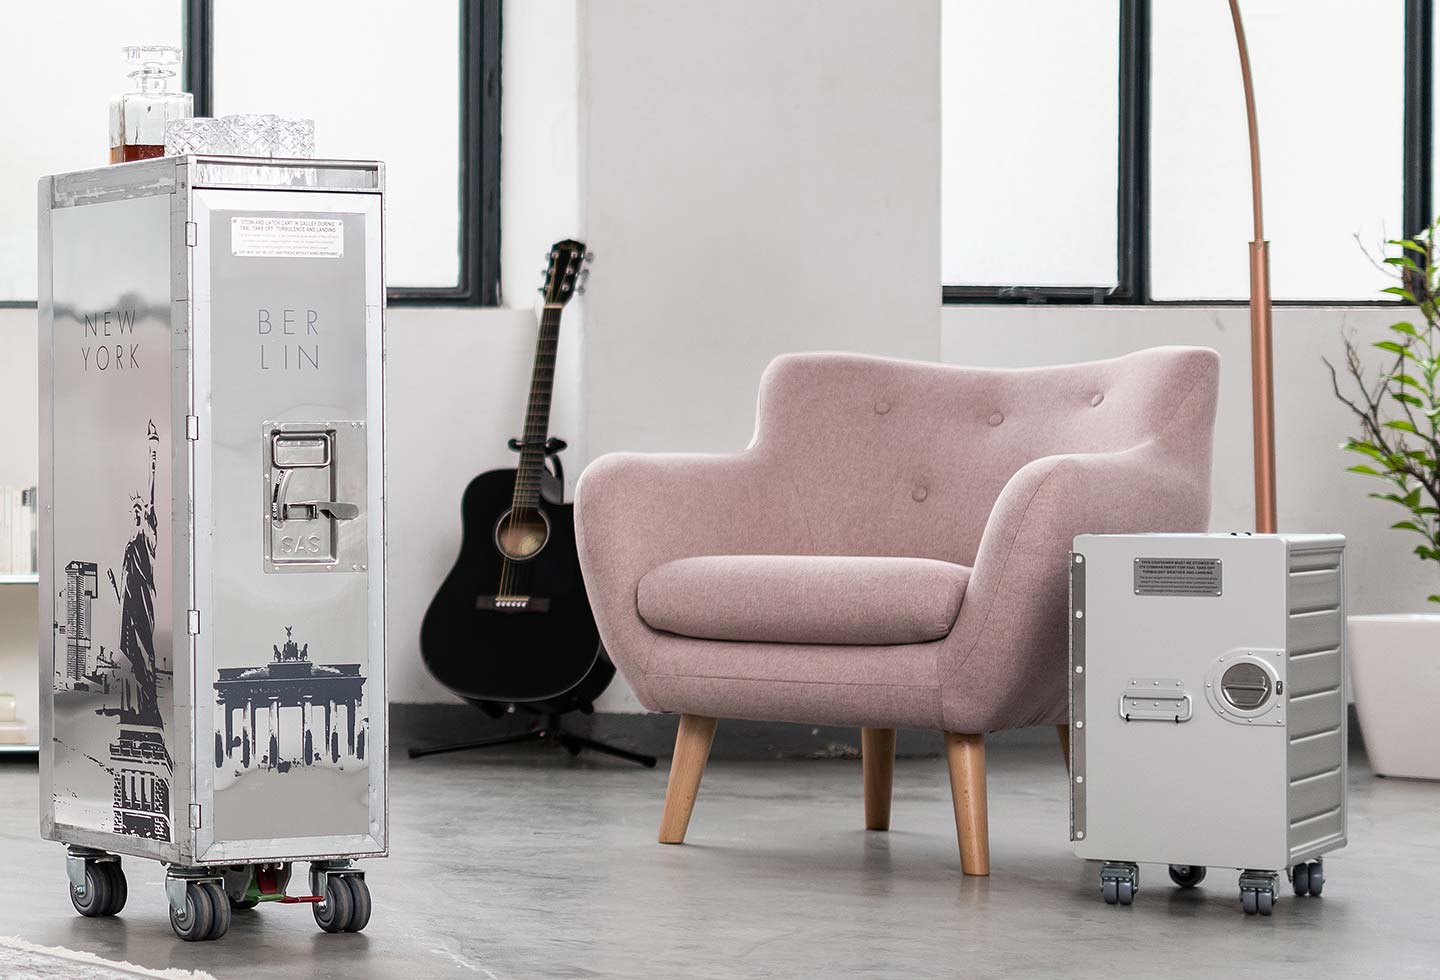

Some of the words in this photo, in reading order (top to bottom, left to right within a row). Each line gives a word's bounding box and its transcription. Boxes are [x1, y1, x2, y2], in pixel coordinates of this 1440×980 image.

[84, 309, 136, 337] NEW
[258, 309, 319, 335] BER
[80, 343, 140, 371] YORK
[260, 344, 320, 370] LIN
[281, 535, 321, 553] SAS
